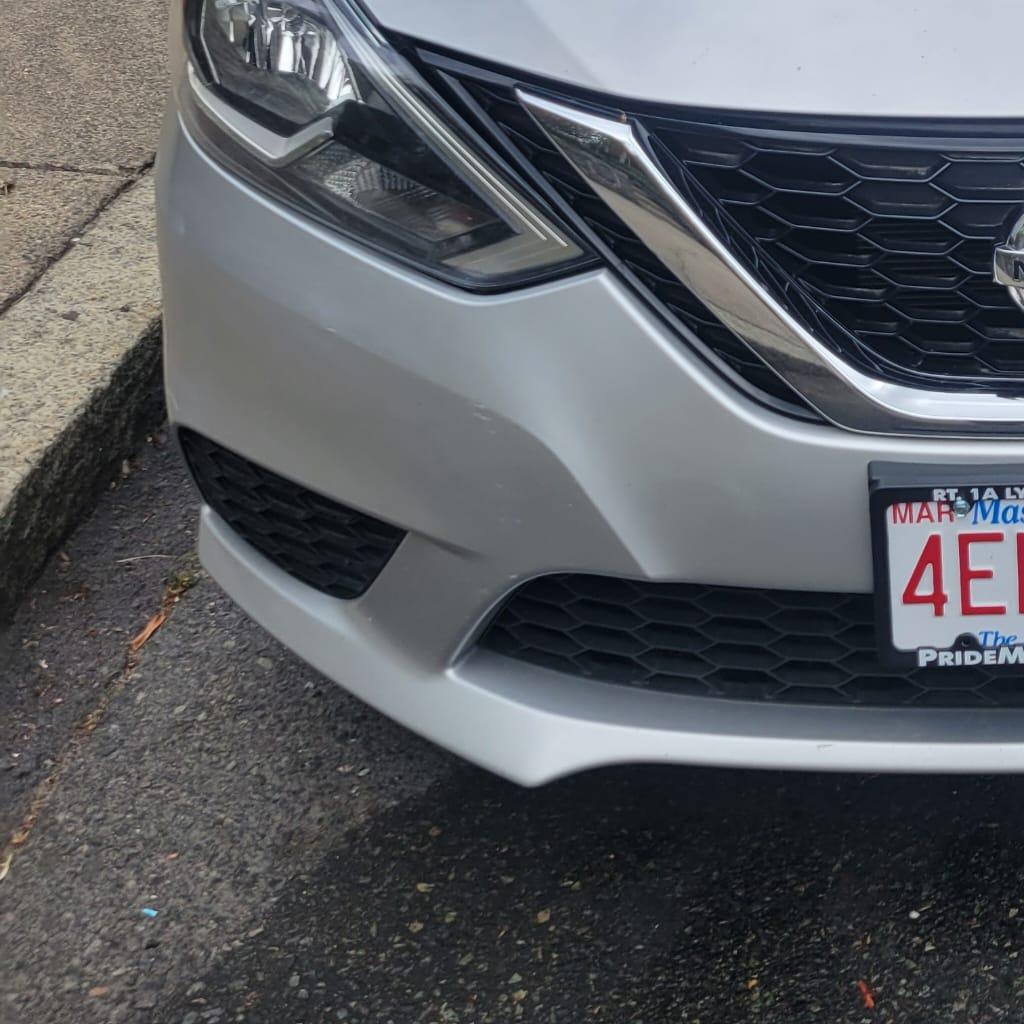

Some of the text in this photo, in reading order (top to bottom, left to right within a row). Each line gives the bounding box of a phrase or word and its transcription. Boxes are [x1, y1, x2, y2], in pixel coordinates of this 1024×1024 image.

[970, 487, 998, 501] 1A
[892, 502, 954, 524] MAR
[978, 630, 1017, 646] The
